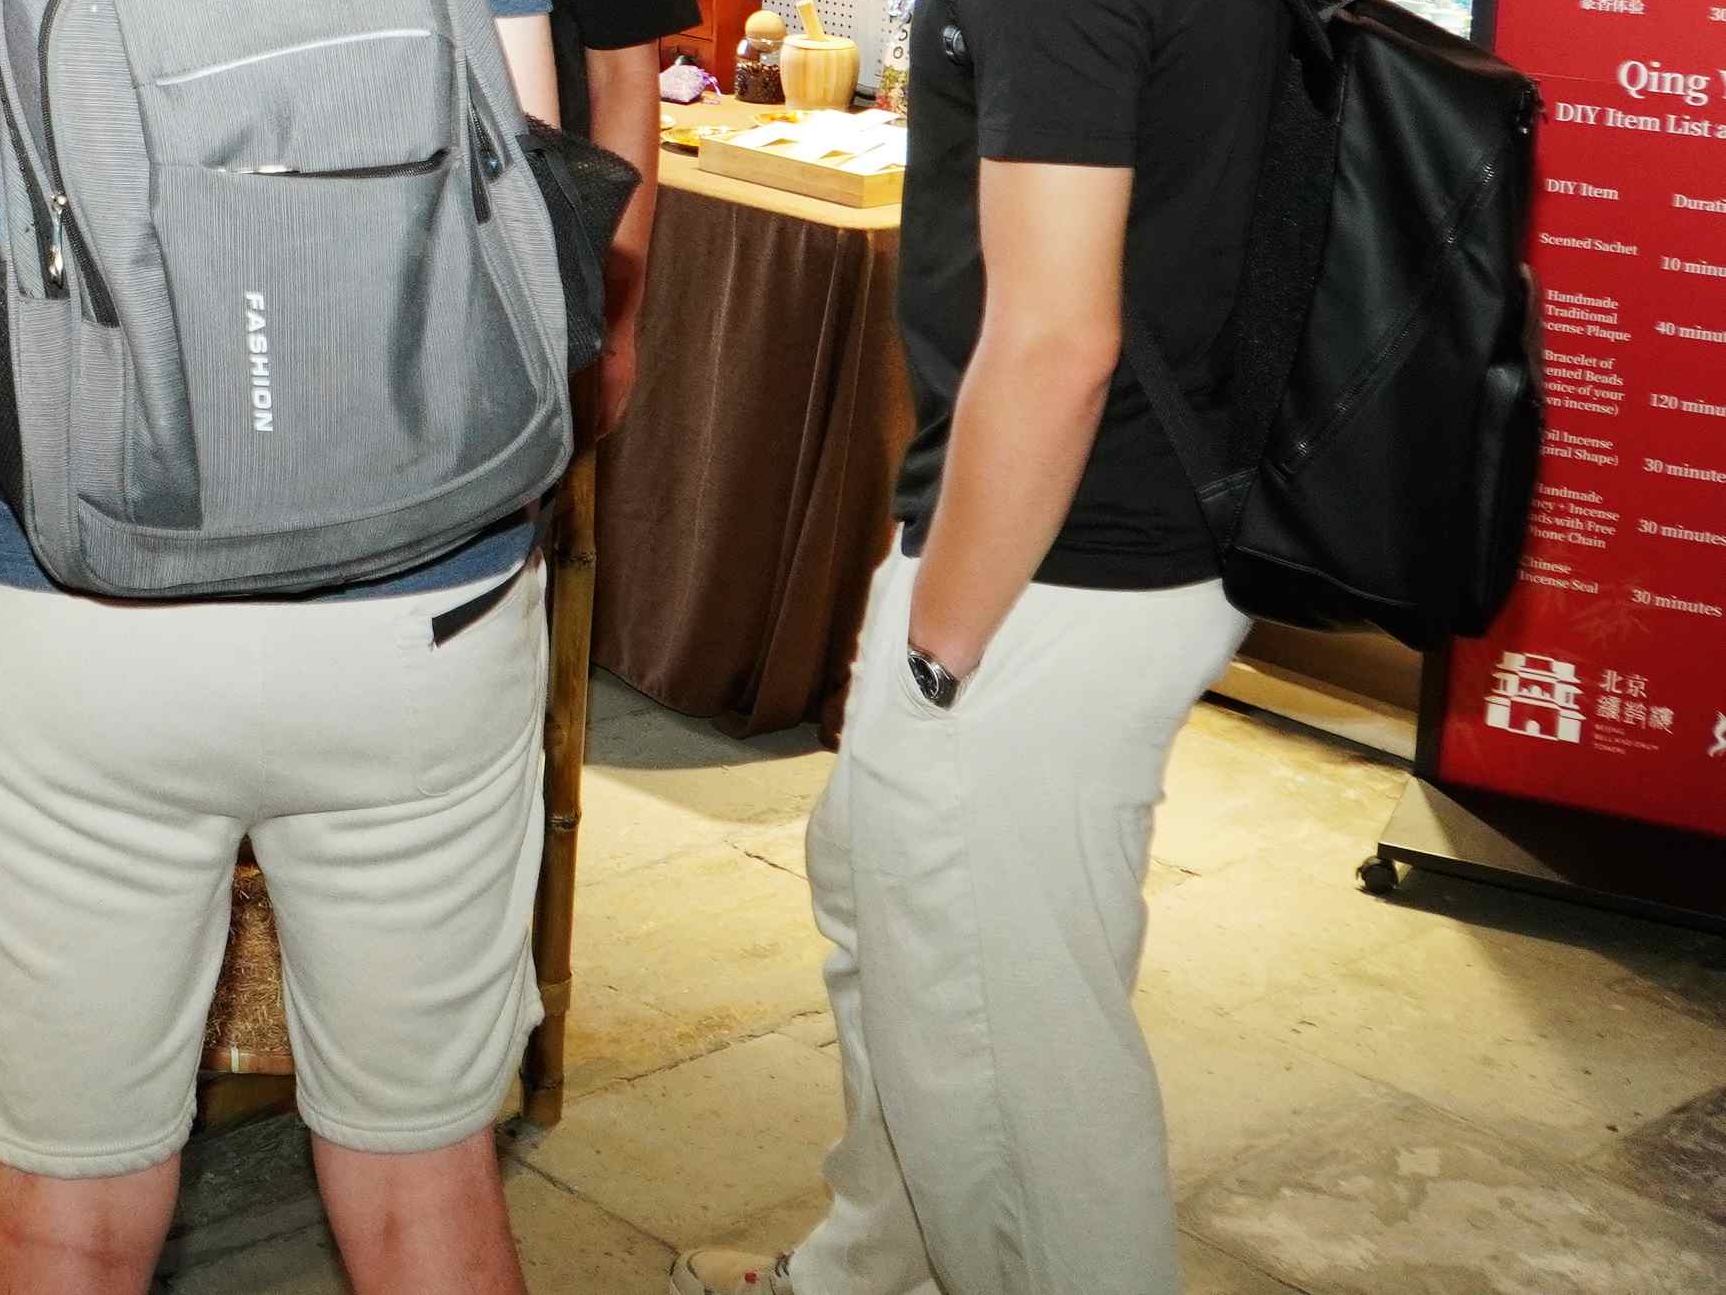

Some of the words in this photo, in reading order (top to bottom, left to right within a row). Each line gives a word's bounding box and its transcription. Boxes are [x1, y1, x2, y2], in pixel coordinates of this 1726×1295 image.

[1619, 60, 1710, 106] Qing
[1556, 102, 1601, 124] DIY
[1605, 107, 1660, 132] Item
[1666, 114, 1711, 138] List
[1546, 178, 1575, 194] DIY
[1581, 183, 1619, 200] Item
[1539, 232, 1591, 250] Scented
[1593, 240, 1638, 255] Sachet
[1661, 256, 1681, 272] 10
[1547, 289, 1619, 309] Handmade
[1545, 305, 1618, 324] Traditional
[1586, 324, 1632, 343] Plaque
[1656, 321, 1675, 336] 40
[246, 292, 273, 431] FASHION
[1544, 349, 1597, 367] Bracelet
[1600, 358, 1615, 369] of
[1545, 366, 1583, 380] ented
[1585, 370, 1624, 386] Beads
[1578, 385, 1591, 396] of
[1594, 388, 1625, 402] your
[1651, 393, 1678, 409] 120
[1563, 432, 1614, 450] Incense
[1643, 458, 1663, 473] 30
[1569, 503, 1620, 521] Incense
[1554, 517, 1584, 530] with
[1586, 521, 1616, 536] Free
[1638, 518, 1658, 534] 30
[1567, 532, 1606, 549] Chain
[1572, 579, 1599, 594] Seal
[1631, 588, 1651, 604] 30
[1654, 596, 1723, 618] minutes
[1598, 669, 1649, 698] 北京
